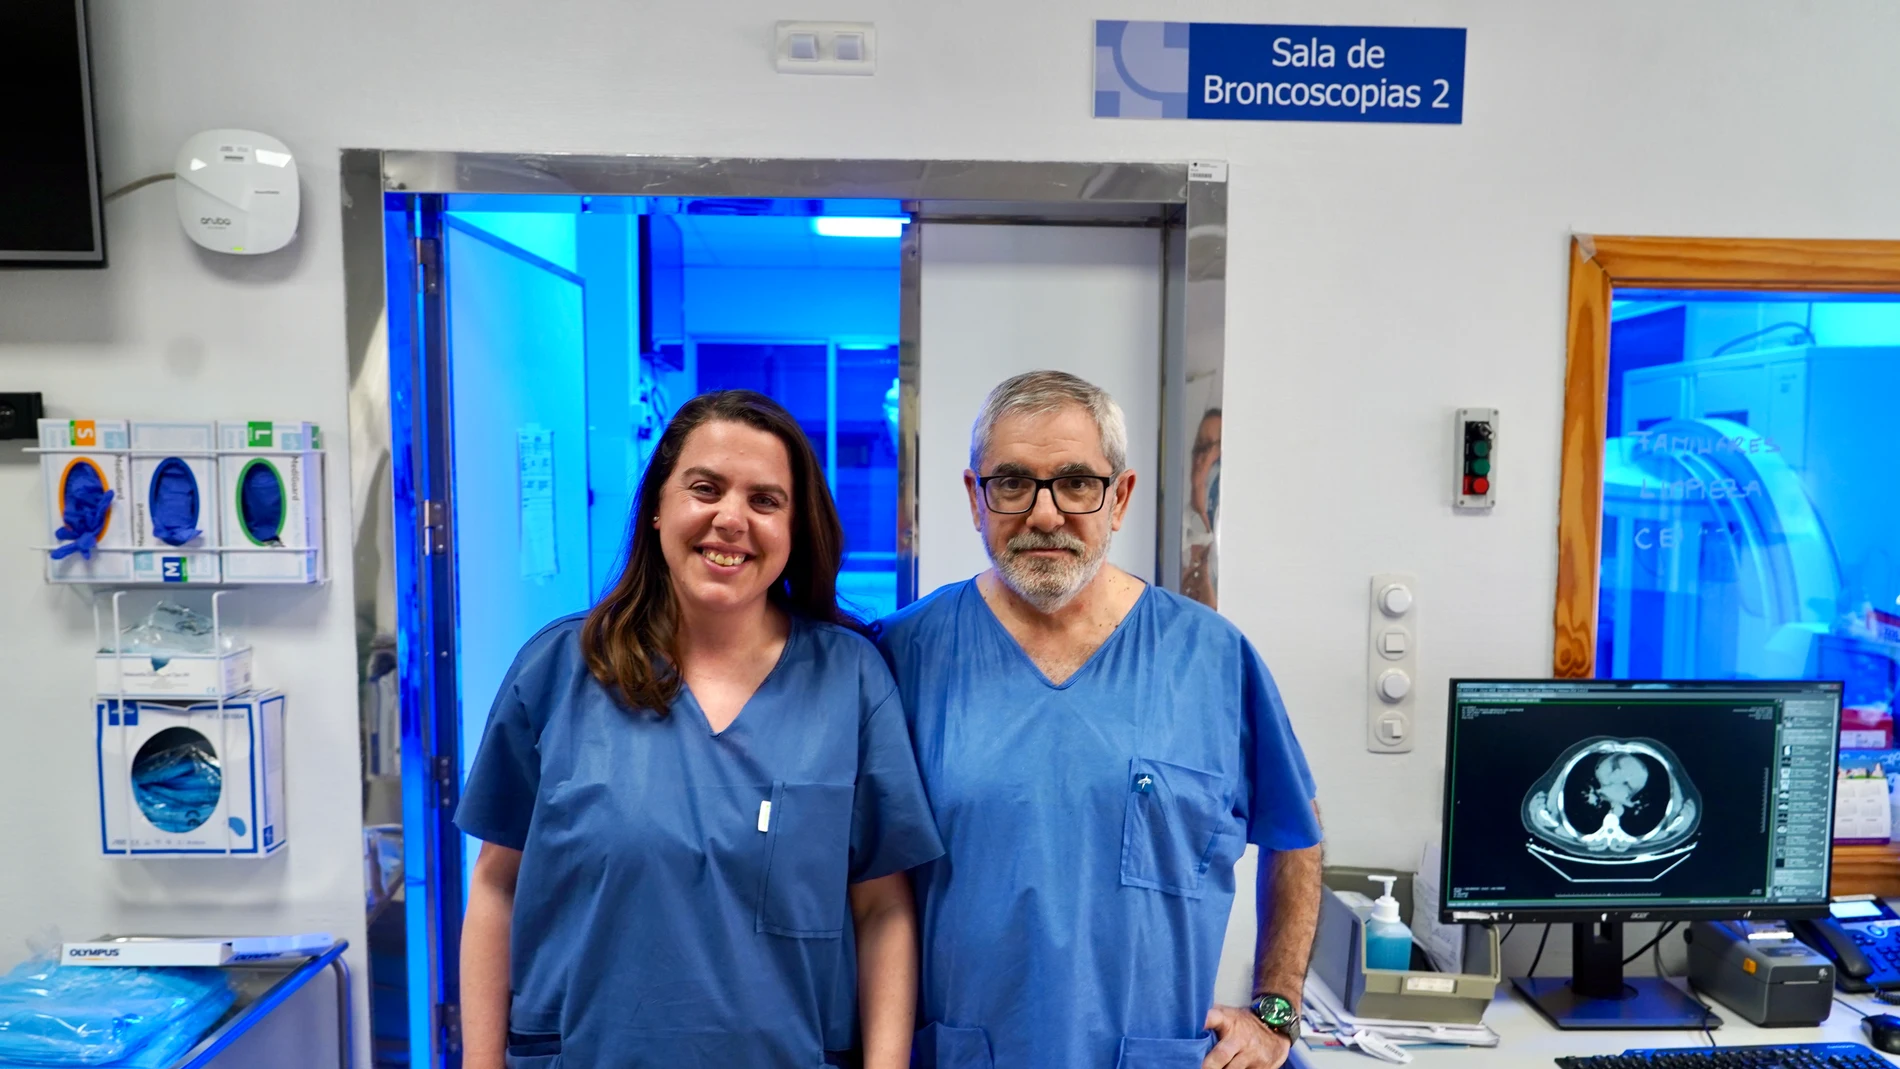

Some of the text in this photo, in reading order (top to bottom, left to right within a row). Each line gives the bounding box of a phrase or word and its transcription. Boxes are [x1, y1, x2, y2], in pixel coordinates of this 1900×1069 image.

[1271, 37, 1386, 69] Sala de
[1203, 74, 1451, 113] Broncoscopias 2
[77, 428, 94, 440] S
[255, 429, 271, 441] L
[1639, 478, 1763, 500] LIMPIEZA
[163, 561, 181, 578] M
[69, 948, 121, 958] OLYMPUS
